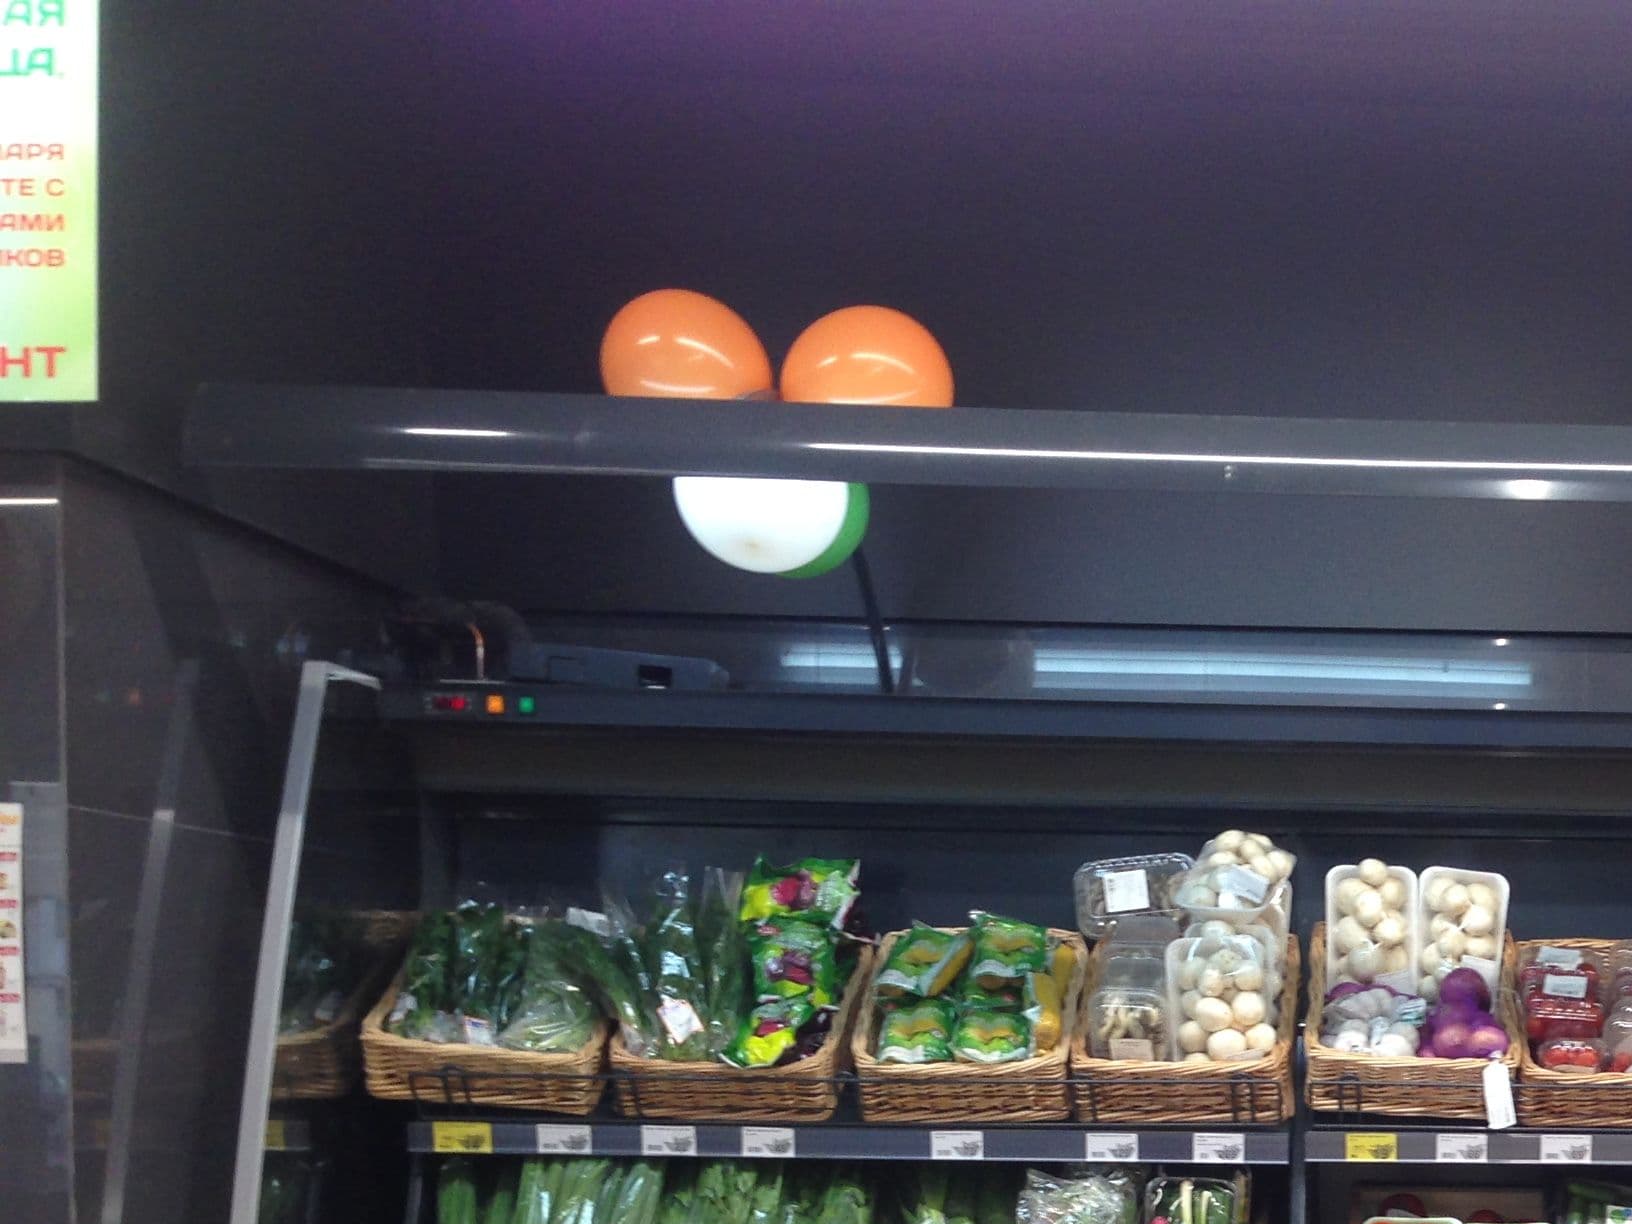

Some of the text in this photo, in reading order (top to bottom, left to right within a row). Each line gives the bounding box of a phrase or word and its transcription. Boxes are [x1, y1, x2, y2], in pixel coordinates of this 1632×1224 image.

[0, 143, 65, 161] АРЯ
[1, 178, 65, 197] ТЕ С
[0, 248, 66, 268] КОВ
[0, 345, 66, 378] НТ
